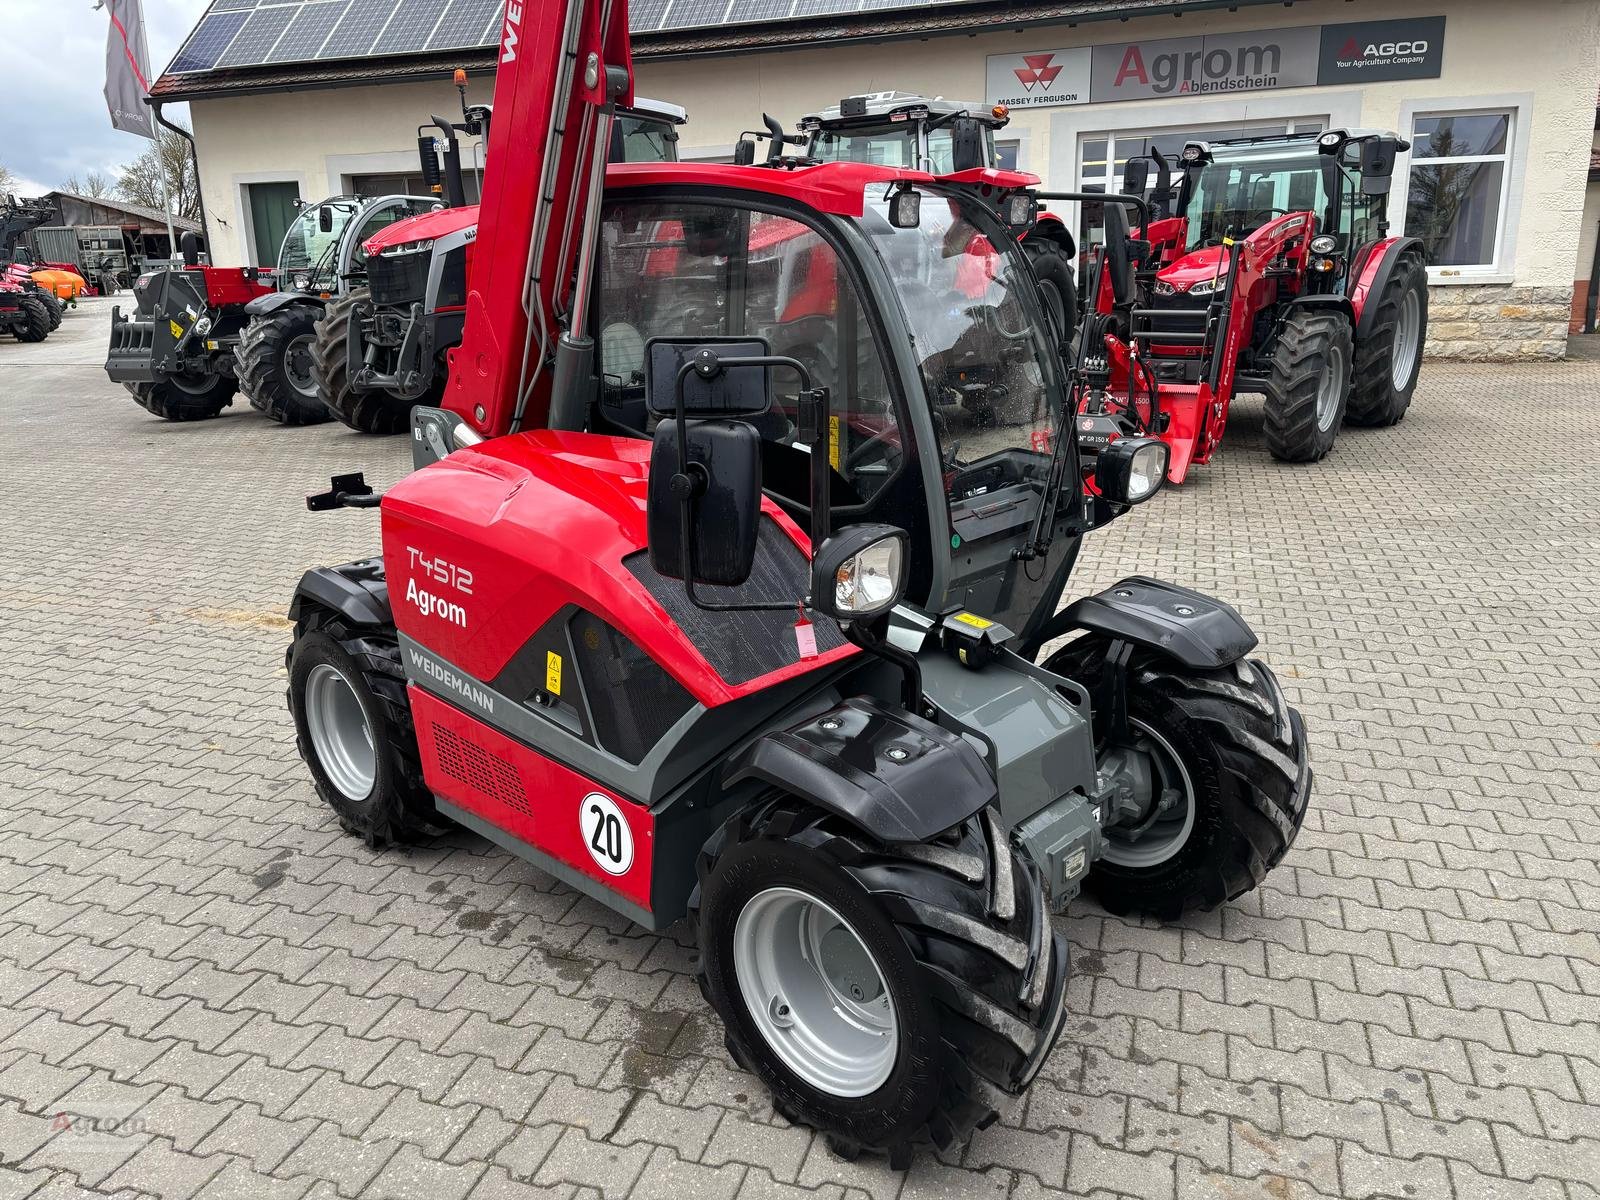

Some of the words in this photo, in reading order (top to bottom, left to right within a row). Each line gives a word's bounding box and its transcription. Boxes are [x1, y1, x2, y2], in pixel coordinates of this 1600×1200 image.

[502, 0, 523, 64] WE
[1363, 40, 1428, 57] AGCO
[1113, 43, 1282, 94] Agrom
[1179, 74, 1278, 94] Abendschein
[1336, 60, 1352, 68] Your
[1352, 57, 1391, 69] Agriculture
[1392, 55, 1425, 64] Company
[997, 97, 1032, 106] MASSEY
[1033, 93, 1078, 104] FERGUSON
[406, 545, 473, 595] T4512
[405, 577, 467, 628] Agrom
[409, 648, 494, 713] WEIDEMANN
[590, 804, 622, 864] 20
